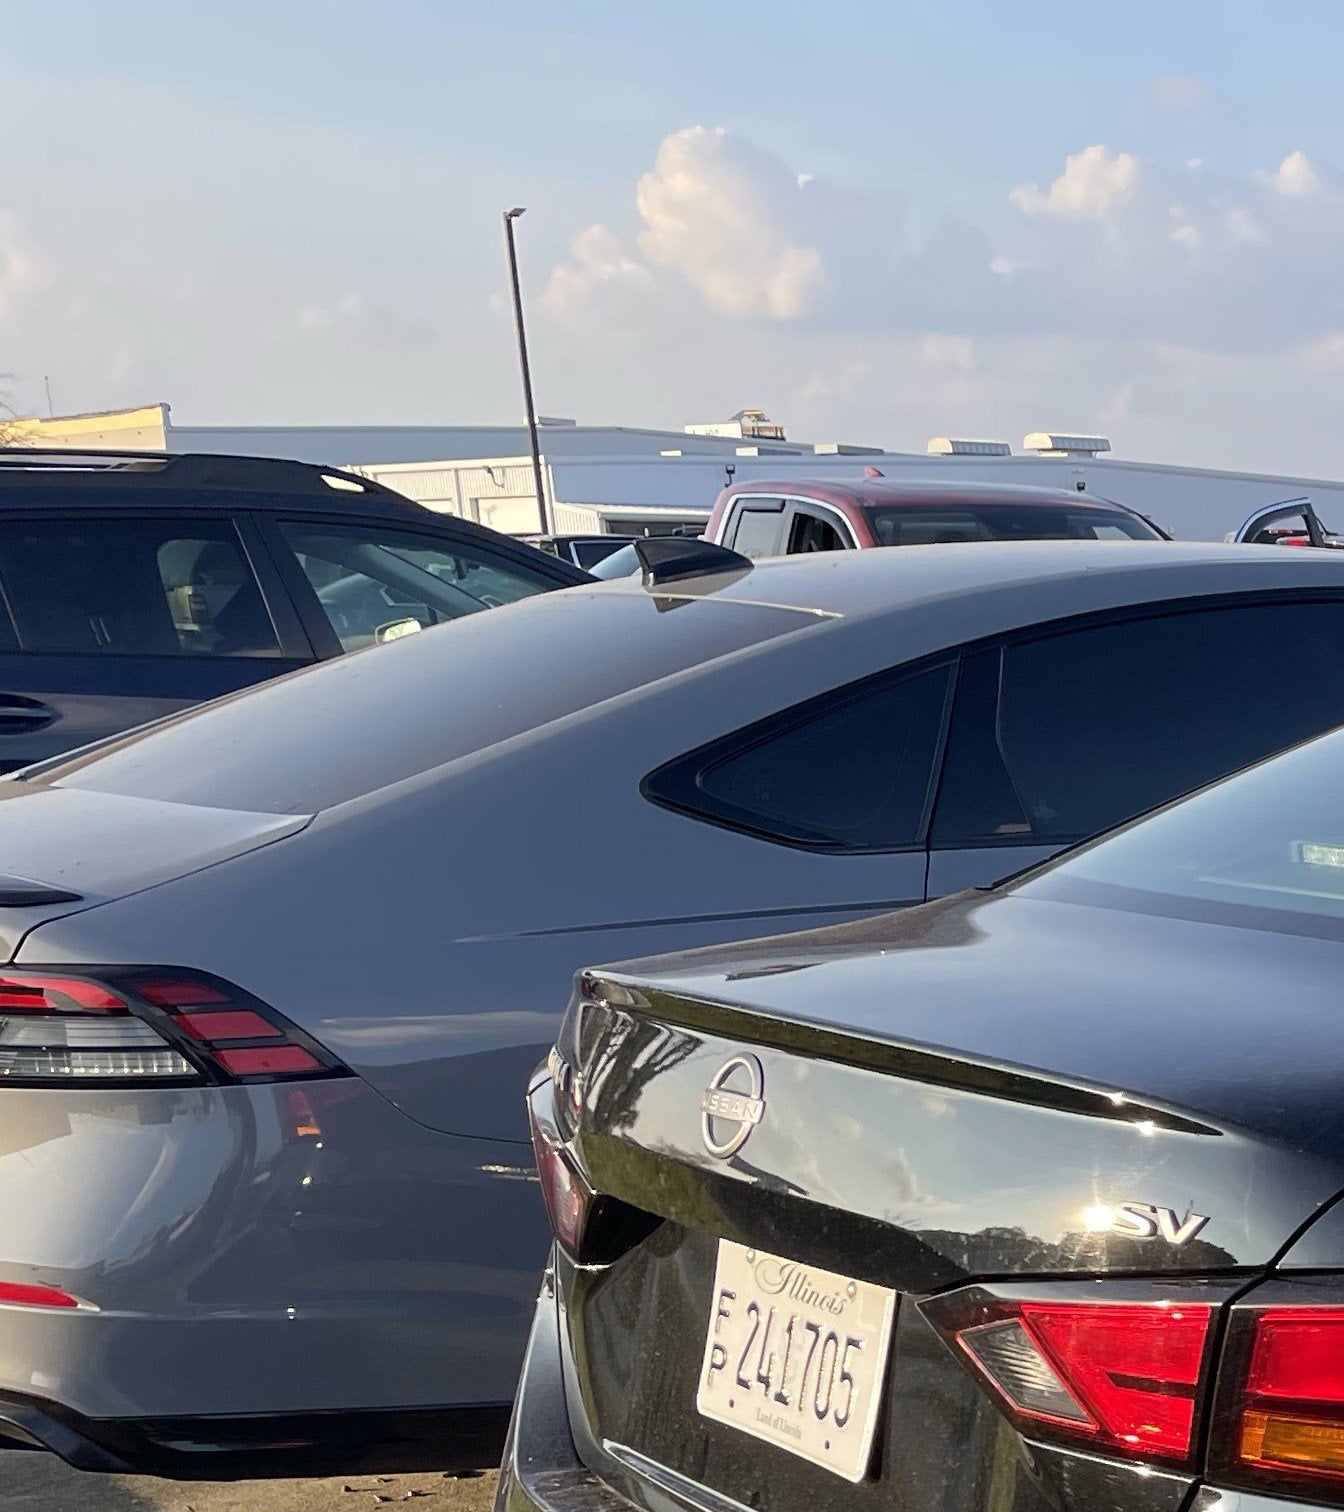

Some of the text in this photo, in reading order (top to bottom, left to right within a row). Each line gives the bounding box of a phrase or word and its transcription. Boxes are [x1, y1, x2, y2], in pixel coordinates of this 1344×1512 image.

[702, 1094, 760, 1119] SSAN
[1111, 1200, 1211, 1244] SV
[755, 1258, 845, 1315] Illinois
[736, 1300, 865, 1428] 241705
